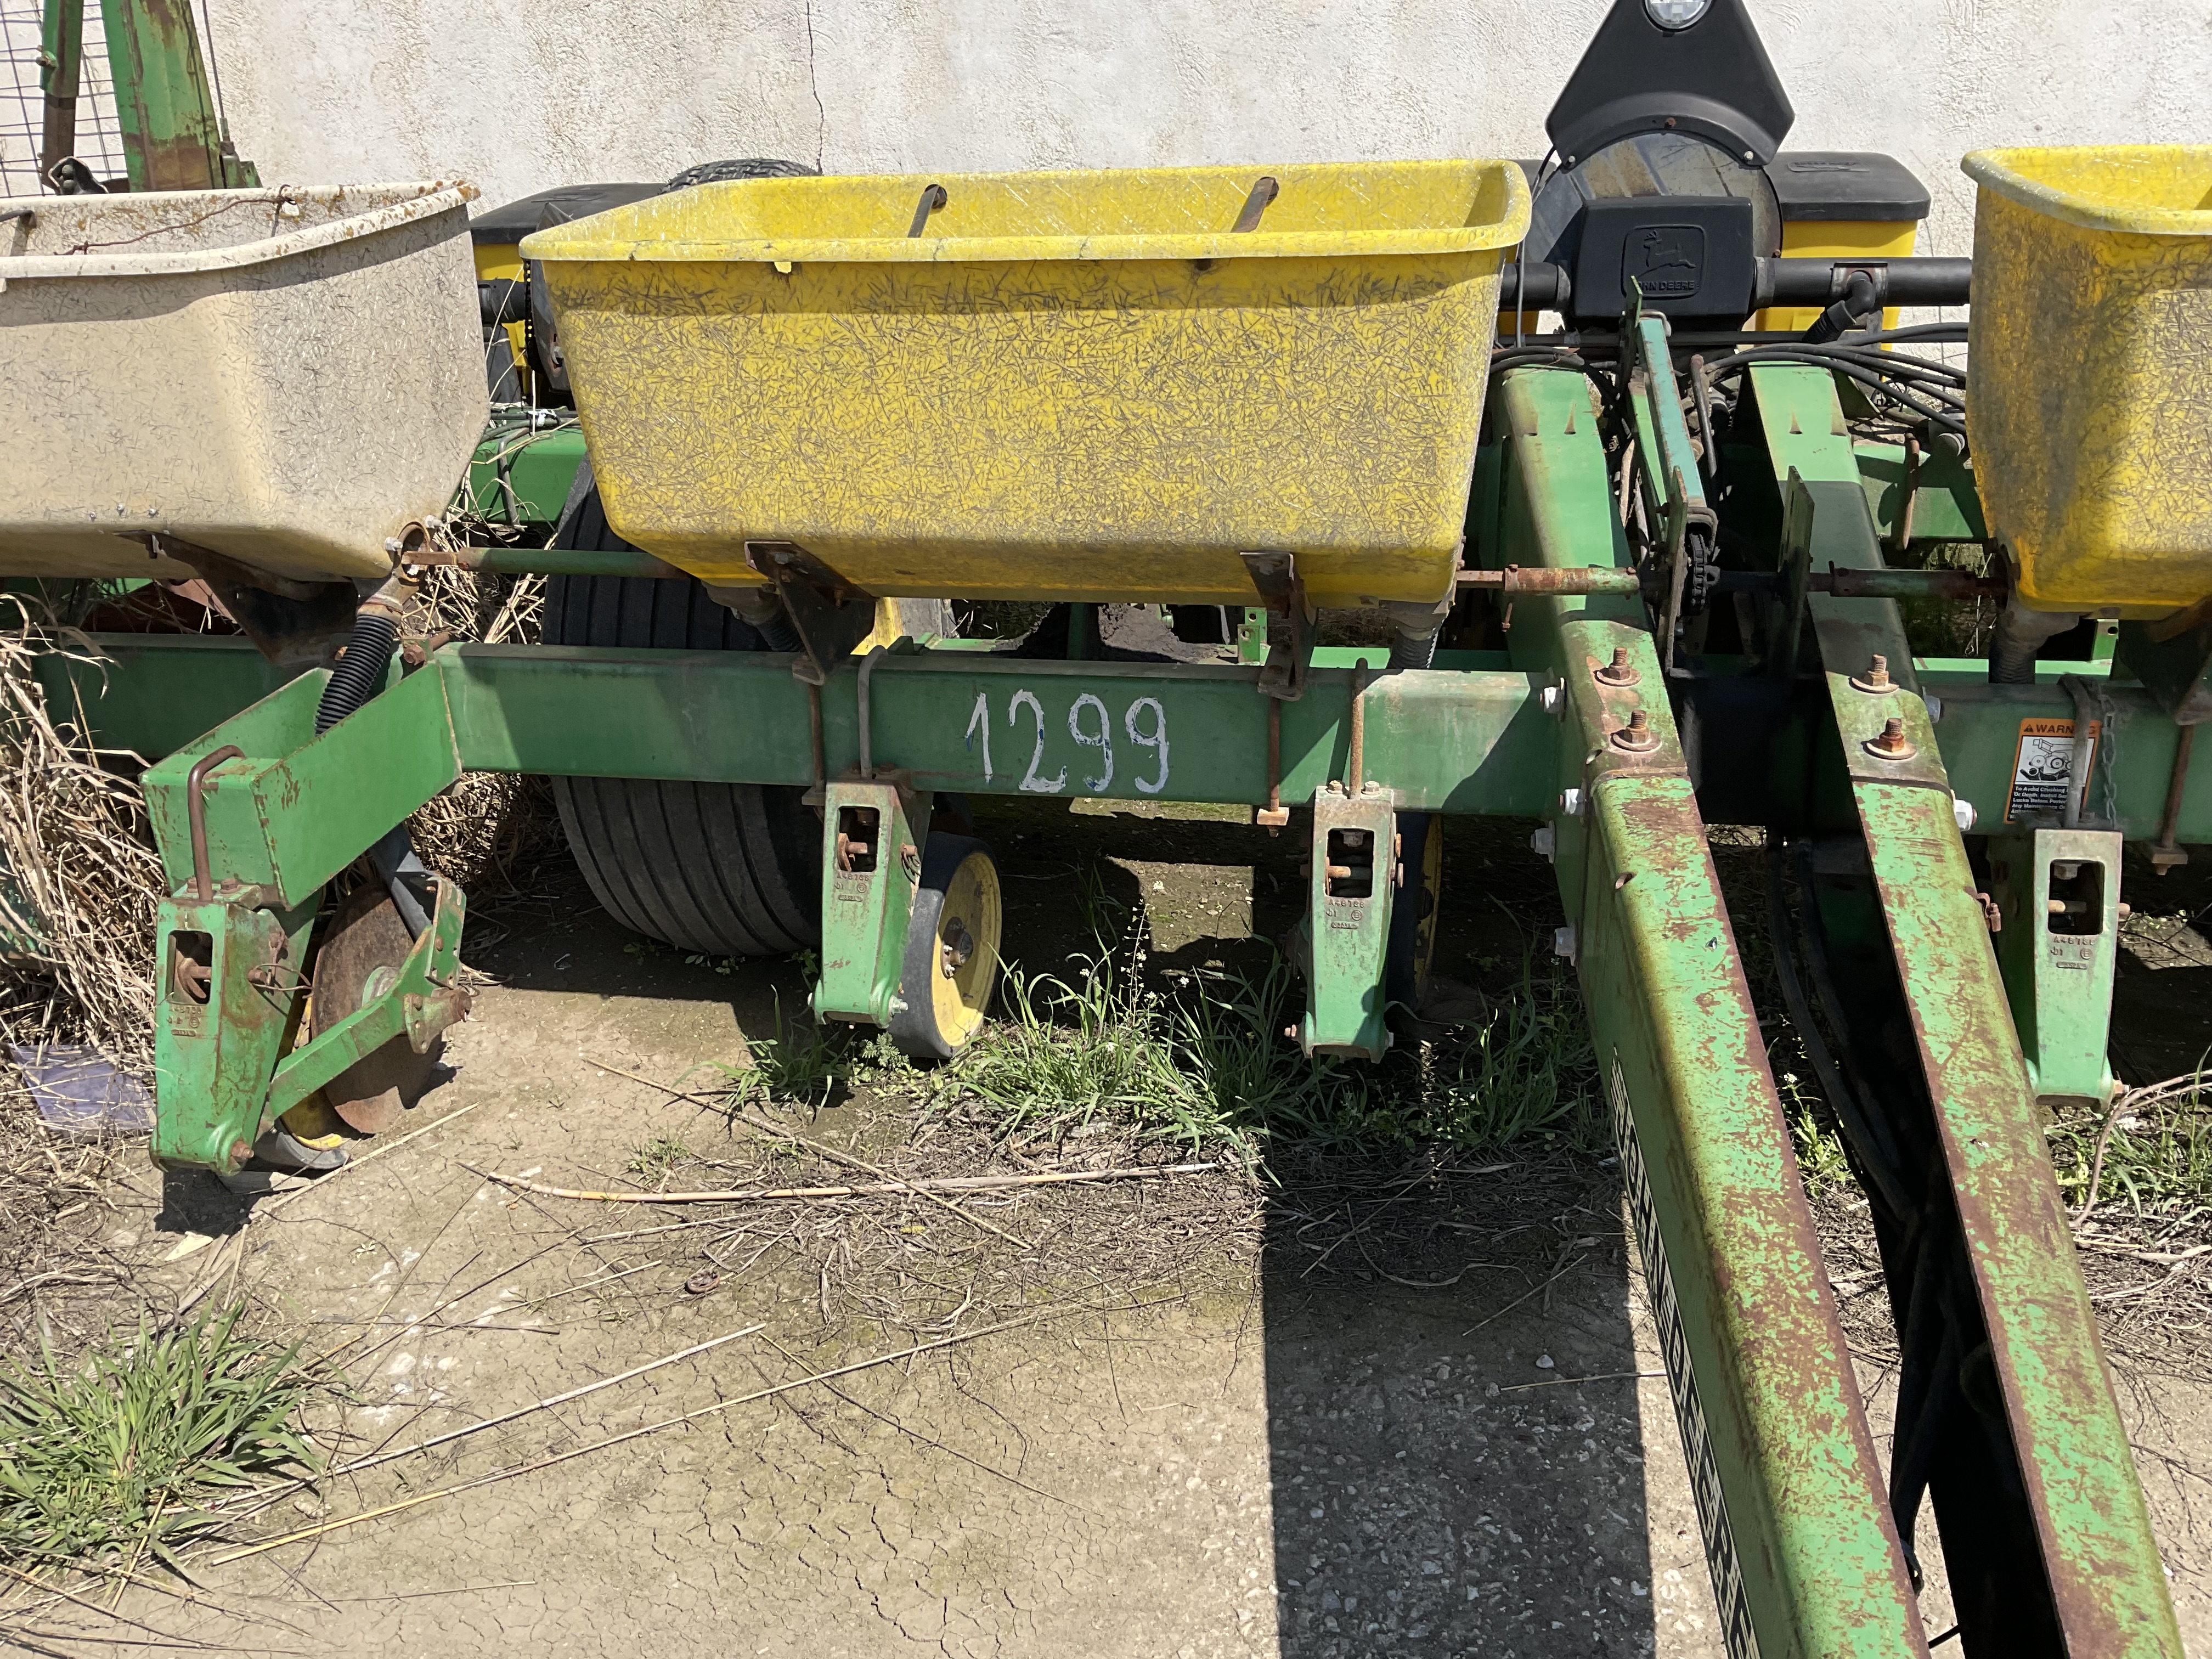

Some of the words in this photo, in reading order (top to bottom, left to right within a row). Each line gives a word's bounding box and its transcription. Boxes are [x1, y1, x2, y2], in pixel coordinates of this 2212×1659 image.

[1658, 280, 1695, 291] DEERE
[2036, 723, 2095, 735] WARNG
[965, 689, 1169, 793] 1299
